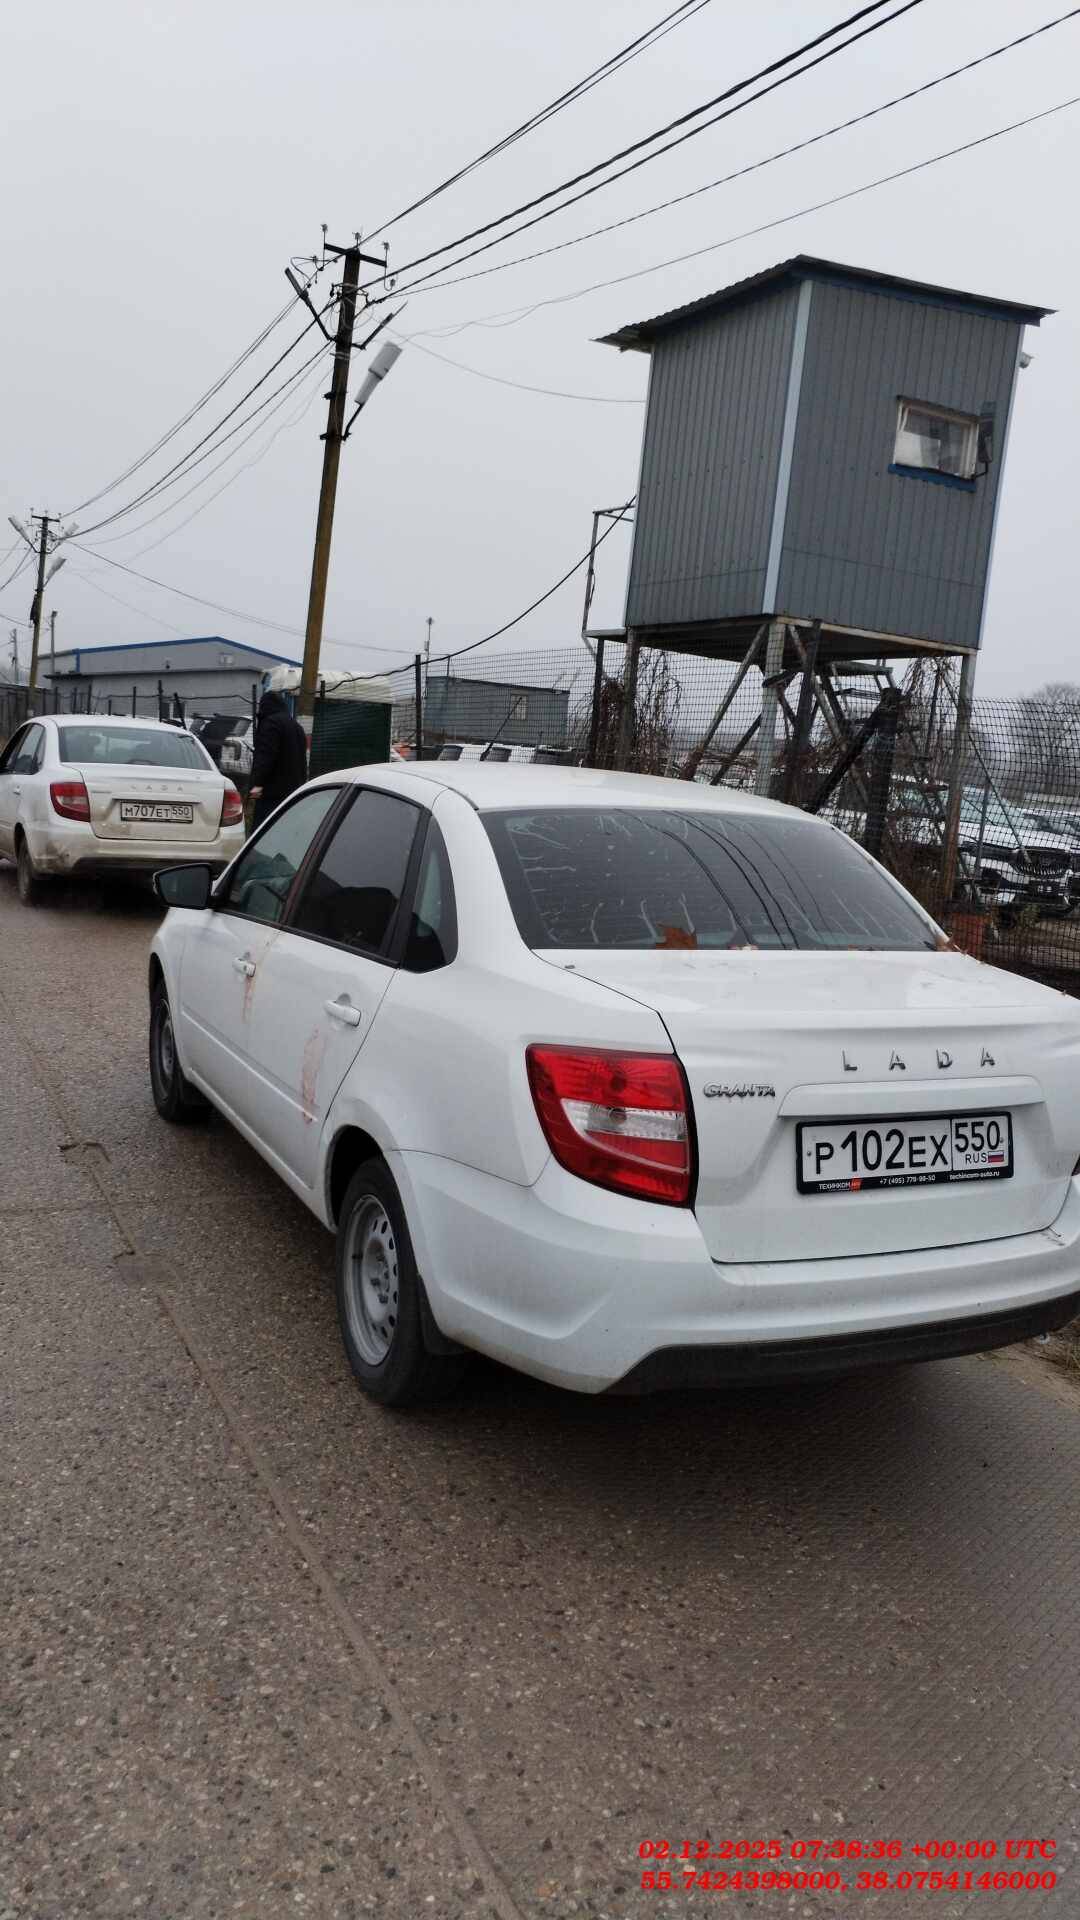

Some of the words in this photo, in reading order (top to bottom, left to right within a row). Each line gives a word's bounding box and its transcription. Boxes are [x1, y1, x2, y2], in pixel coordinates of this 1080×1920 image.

[171, 804, 190, 816] 550
[841, 1047, 996, 1072] LADA
[703, 1081, 776, 1099] GRANTA
[814, 1128, 949, 1175] Р102ЕХ
[954, 1120, 1001, 1153] 550
[964, 1151, 988, 1164] RUS
